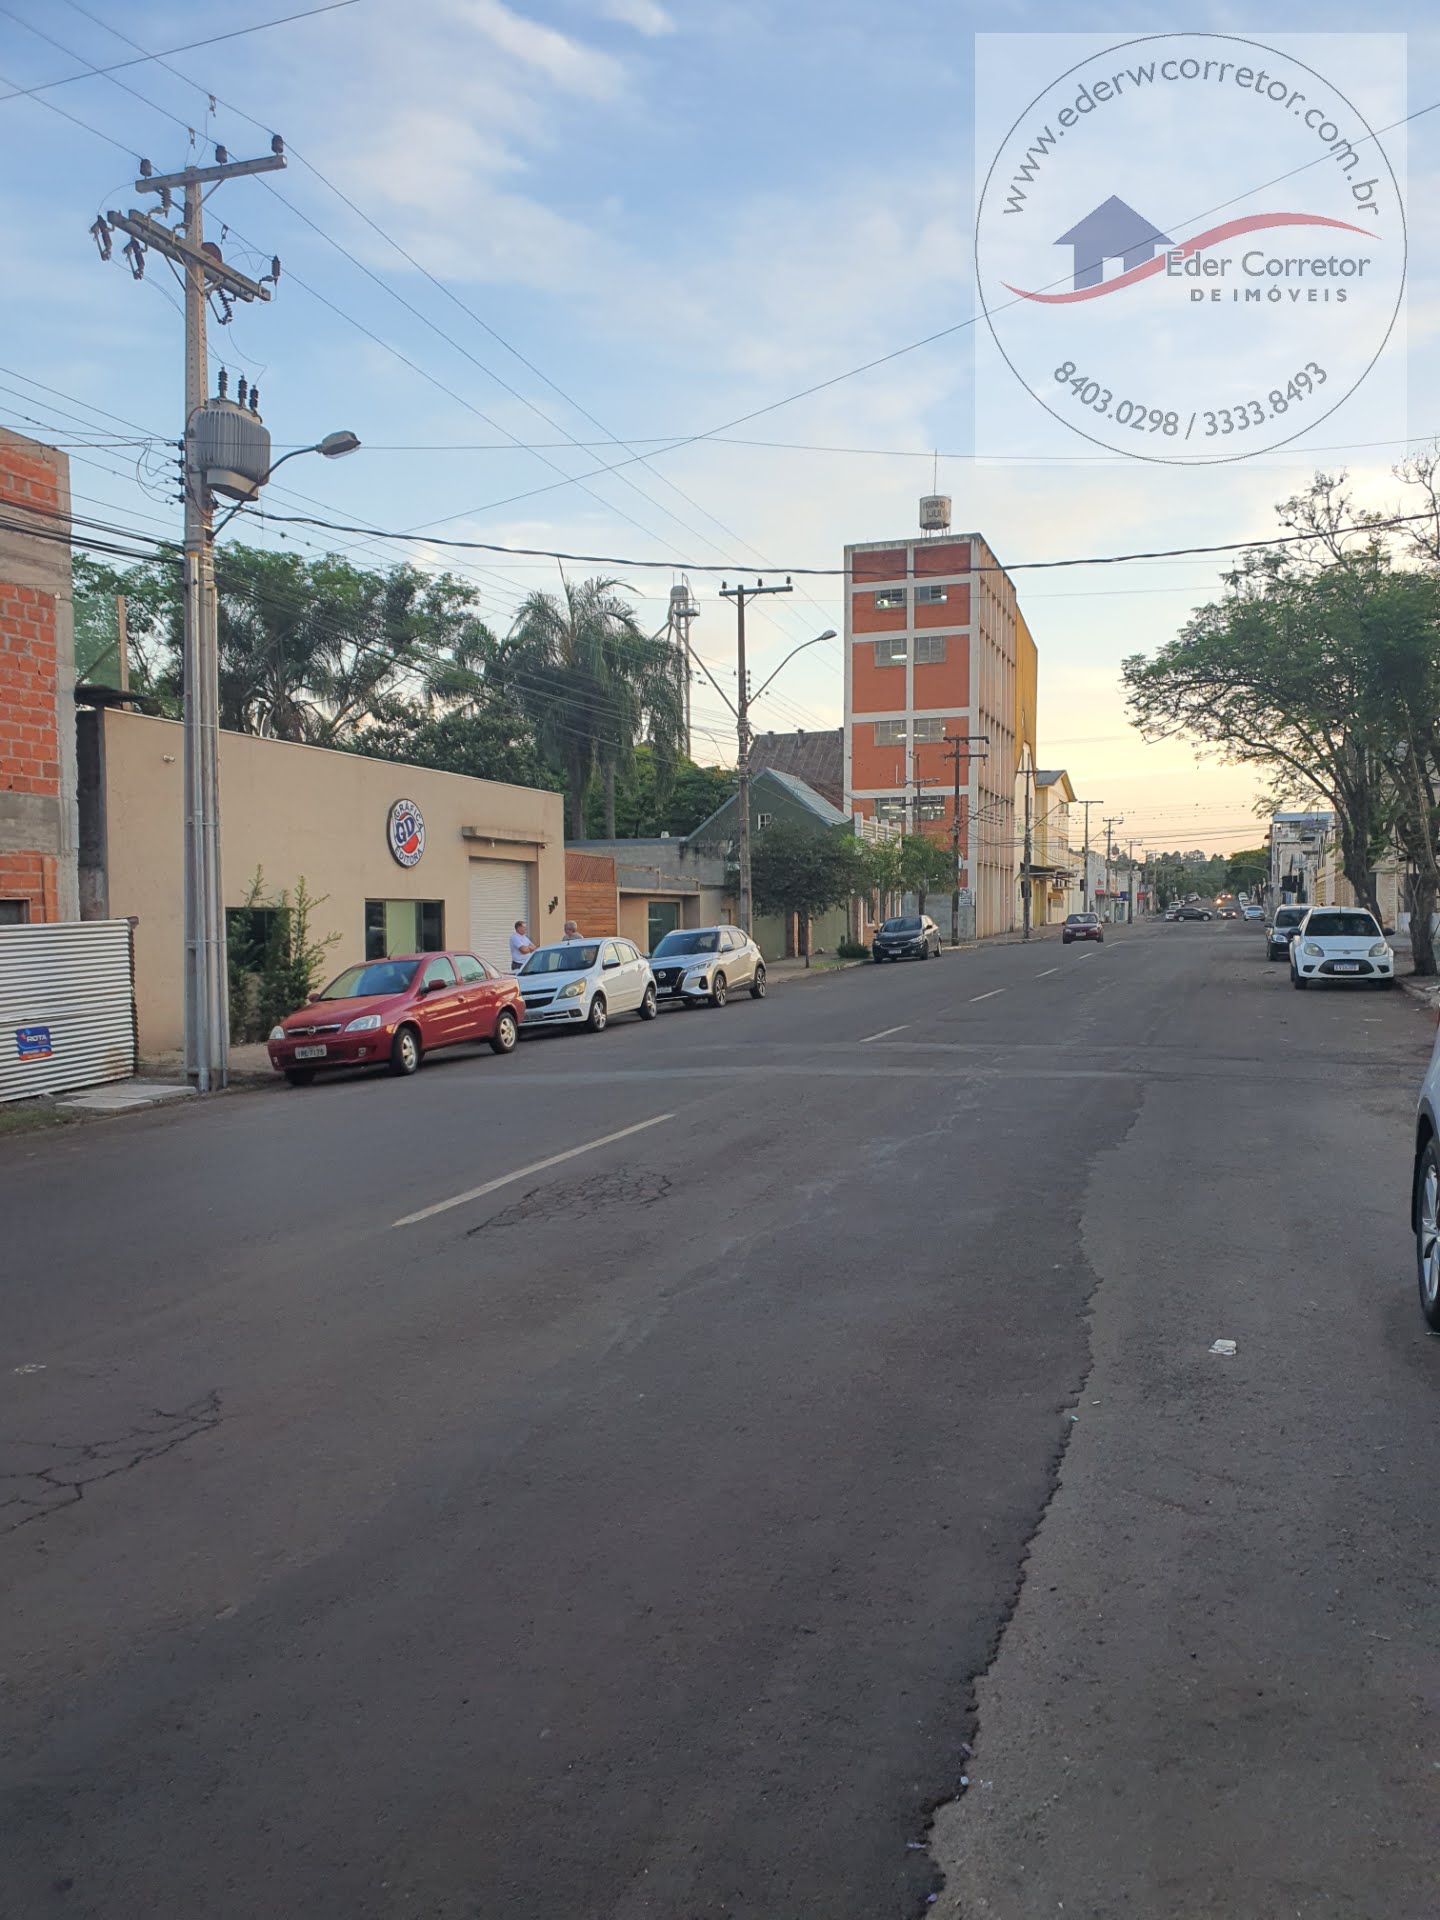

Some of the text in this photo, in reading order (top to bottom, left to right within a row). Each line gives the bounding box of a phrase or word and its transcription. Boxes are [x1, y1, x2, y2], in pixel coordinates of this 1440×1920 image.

[396, 817, 415, 844] GD
[395, 847, 423, 864] EDITORA
[26, 1034, 48, 1042] ROTA
